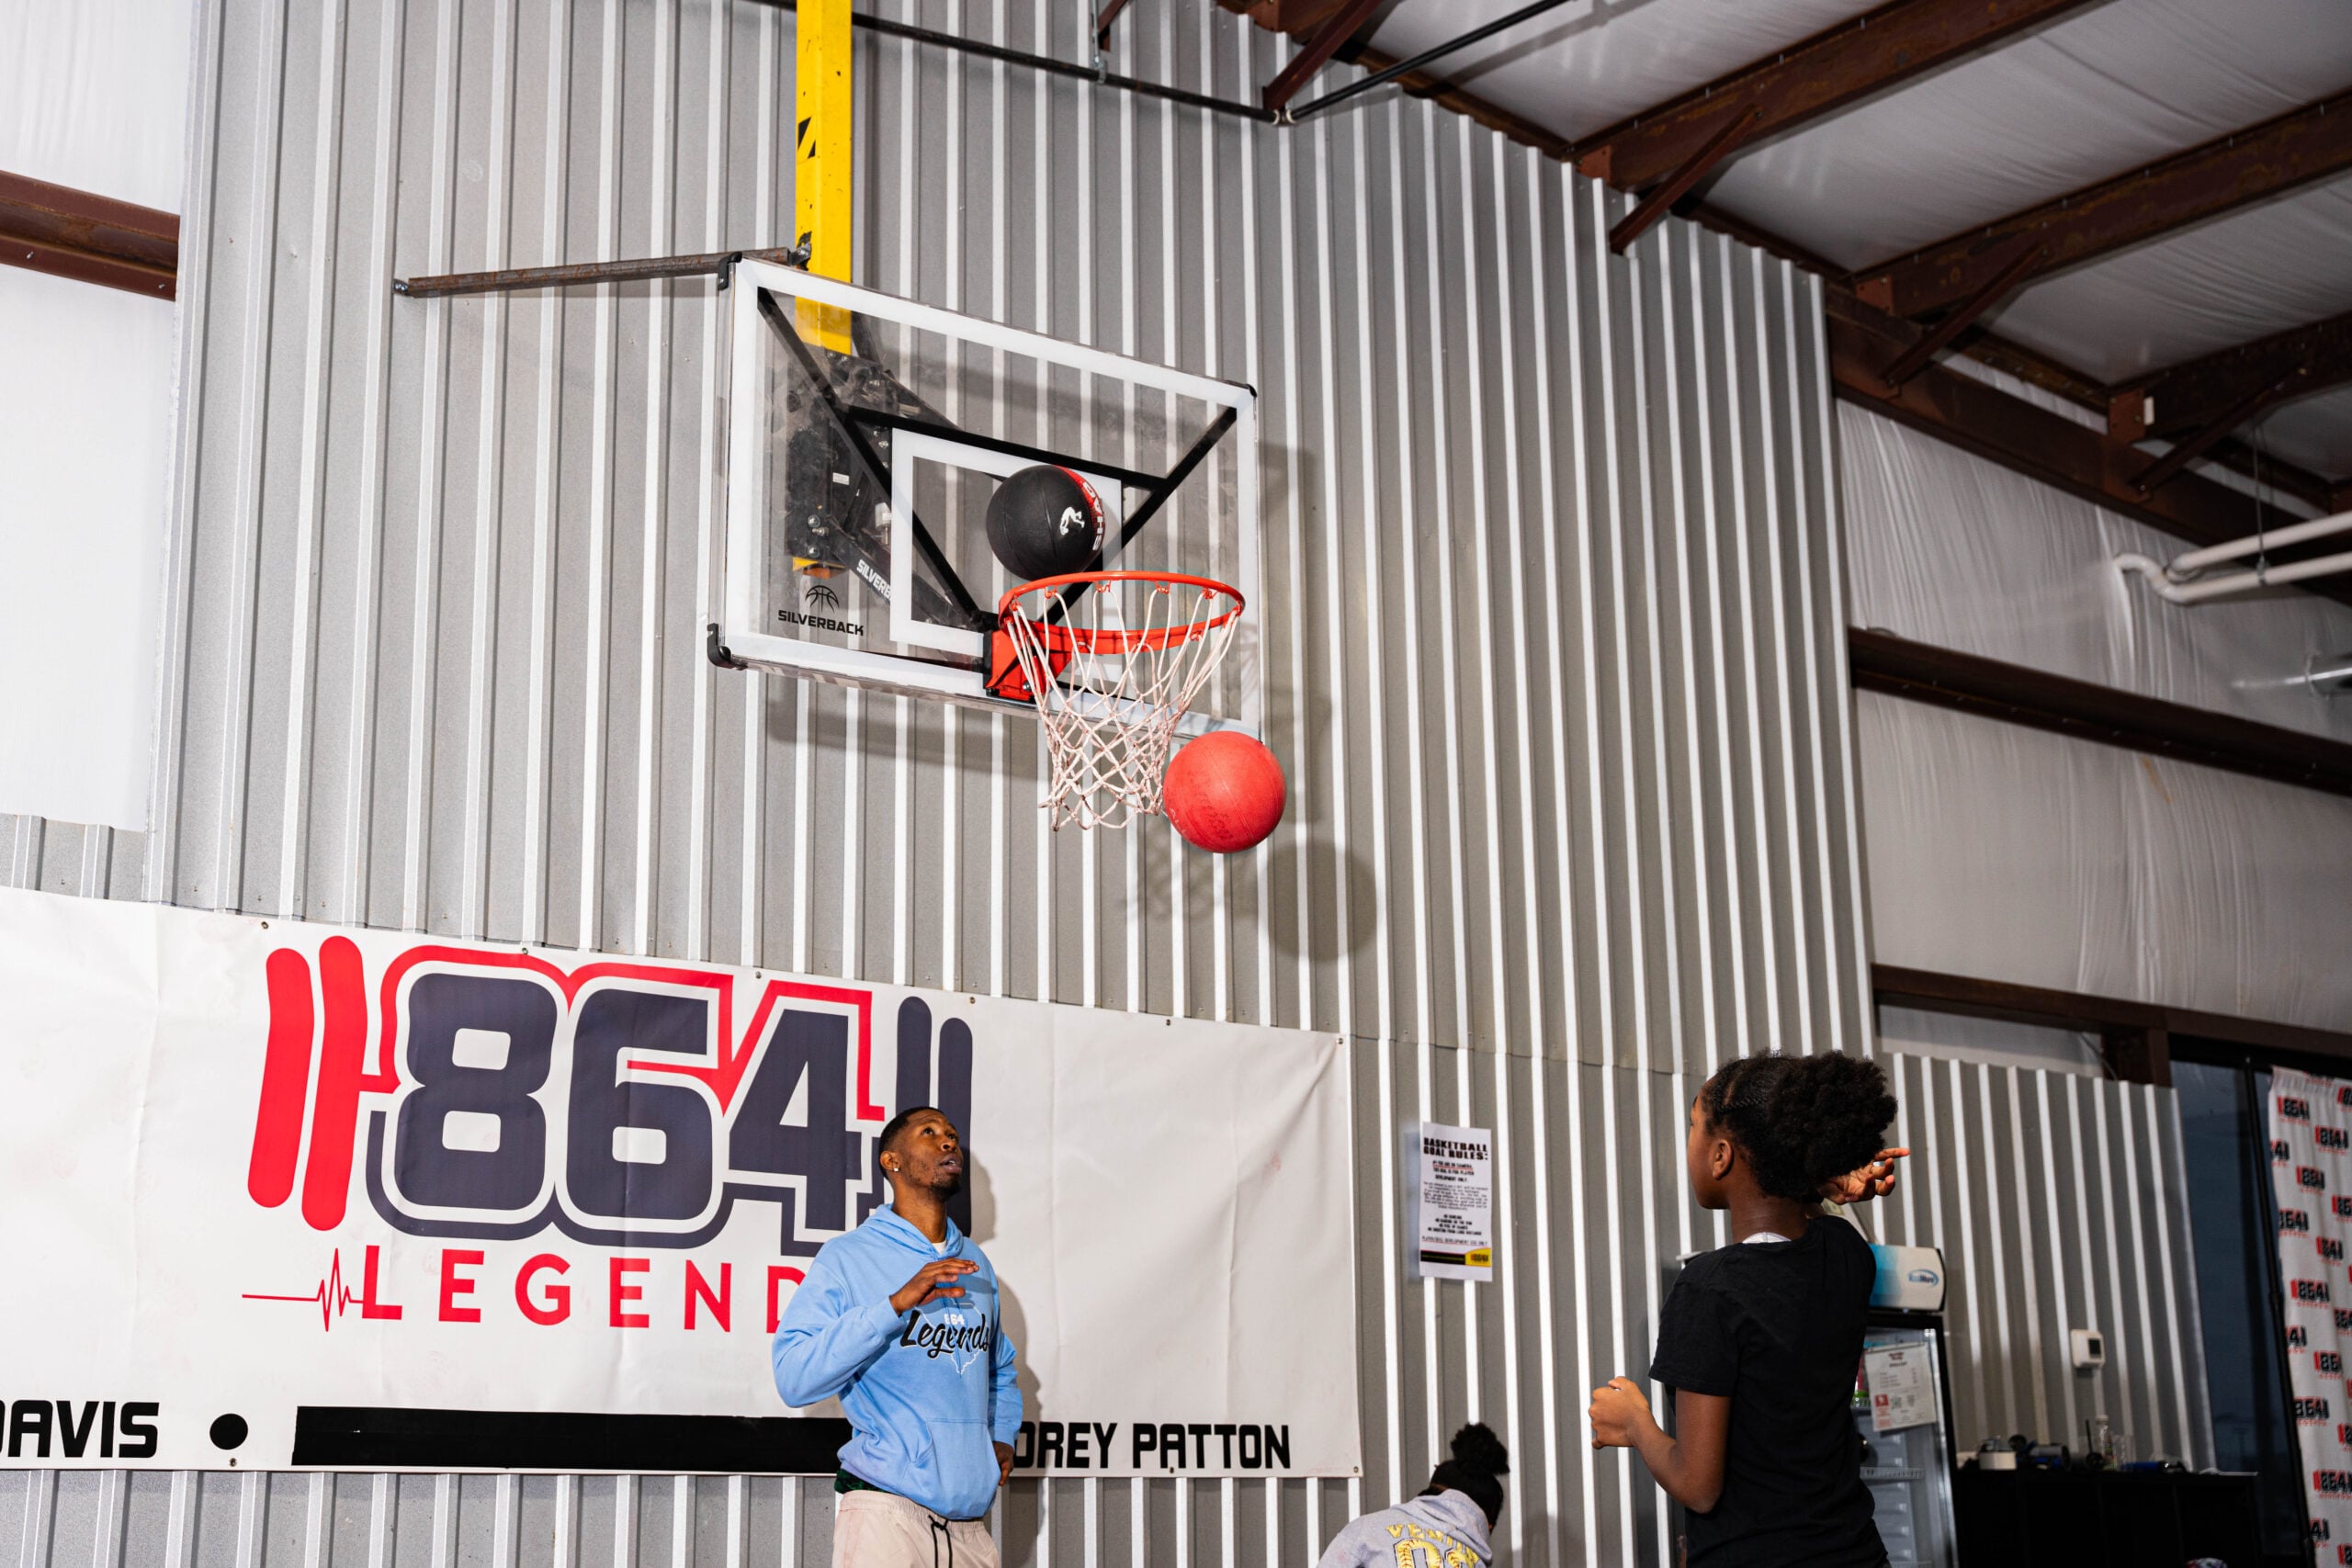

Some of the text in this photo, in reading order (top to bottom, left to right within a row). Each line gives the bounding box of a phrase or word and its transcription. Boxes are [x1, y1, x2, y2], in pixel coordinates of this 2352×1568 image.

[778, 610, 865, 637] SILVERBACK
[390, 969, 865, 1235] 864
[1423, 1137, 1487, 1152] BASKETBALL
[1423, 1146, 1445, 1157] GOAL
[900, 1309, 989, 1359] Legends
[0, 1399, 160, 1459] AVIS
[1133, 1423, 1291, 1469] PATTON
